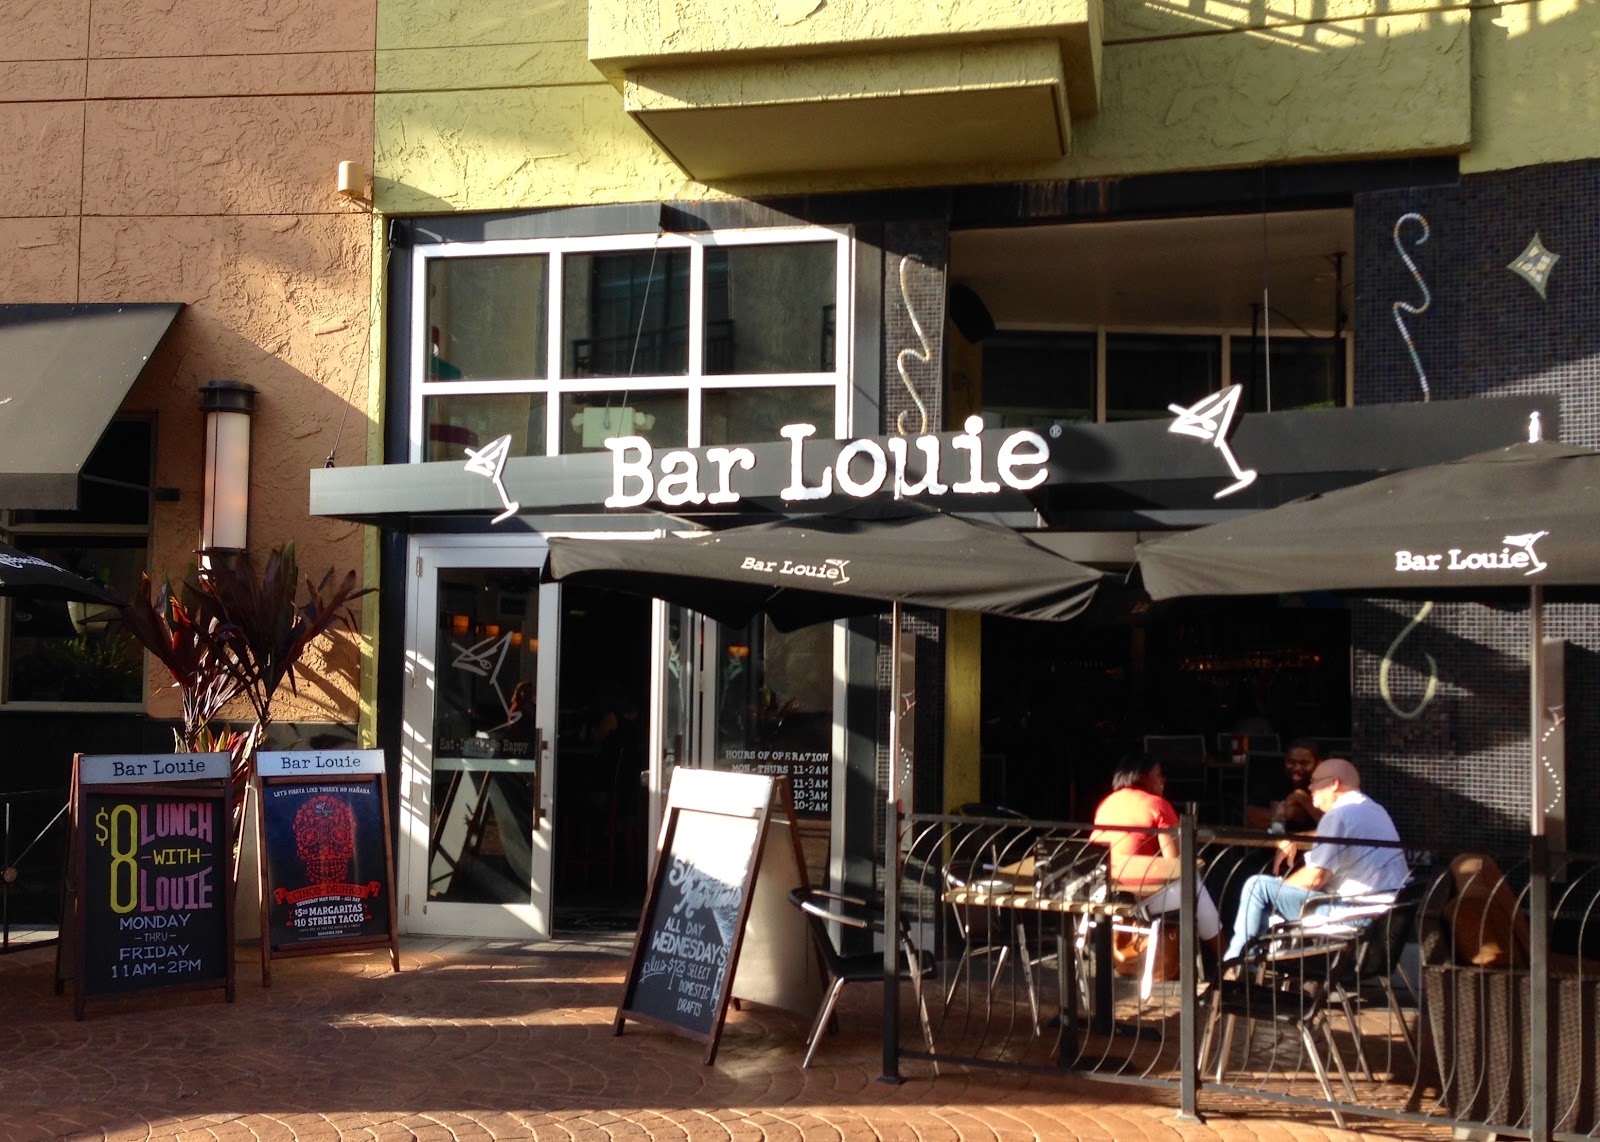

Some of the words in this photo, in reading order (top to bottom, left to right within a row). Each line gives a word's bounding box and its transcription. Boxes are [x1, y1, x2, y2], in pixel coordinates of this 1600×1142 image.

[604, 435, 756, 508] Bar
[780, 415, 1050, 500] Louie
[740, 557, 777, 572] Bar
[779, 561, 839, 579] Louie
[1395, 550, 1442, 571] Bar
[1447, 548, 1529, 570] Louie
[281, 757, 311, 769] Bar
[315, 756, 361, 769] Louie
[725, 750, 756, 760] HOURS
[757, 750, 770, 760] OF
[772, 750, 829, 762] OPERATION
[112, 761, 148, 777] Bar
[153, 759, 206, 775] Louie
[140, 802, 213, 847] LUNCH
[140, 866, 213, 912] LOUIE
[293, 886, 321, 900] CINCO
[326, 884, 362, 896] DRINKO
[309, 903, 363, 916] MARGARITAS
[119, 913, 191, 931] MONDAY
[294, 919, 307, 928] $10
[308, 915, 337, 926] STREET
[338, 913, 364, 924] TACOS
[664, 916, 681, 933] ALL
[685, 921, 706, 937] DAY
[119, 944, 190, 961] FRIDAY
[651, 930, 728, 966] WEDNESDAYS
[687, 963, 711, 981] SELECT
[678, 980, 711, 1000] DOMESTIC
[676, 997, 703, 1017] DRAFTS
